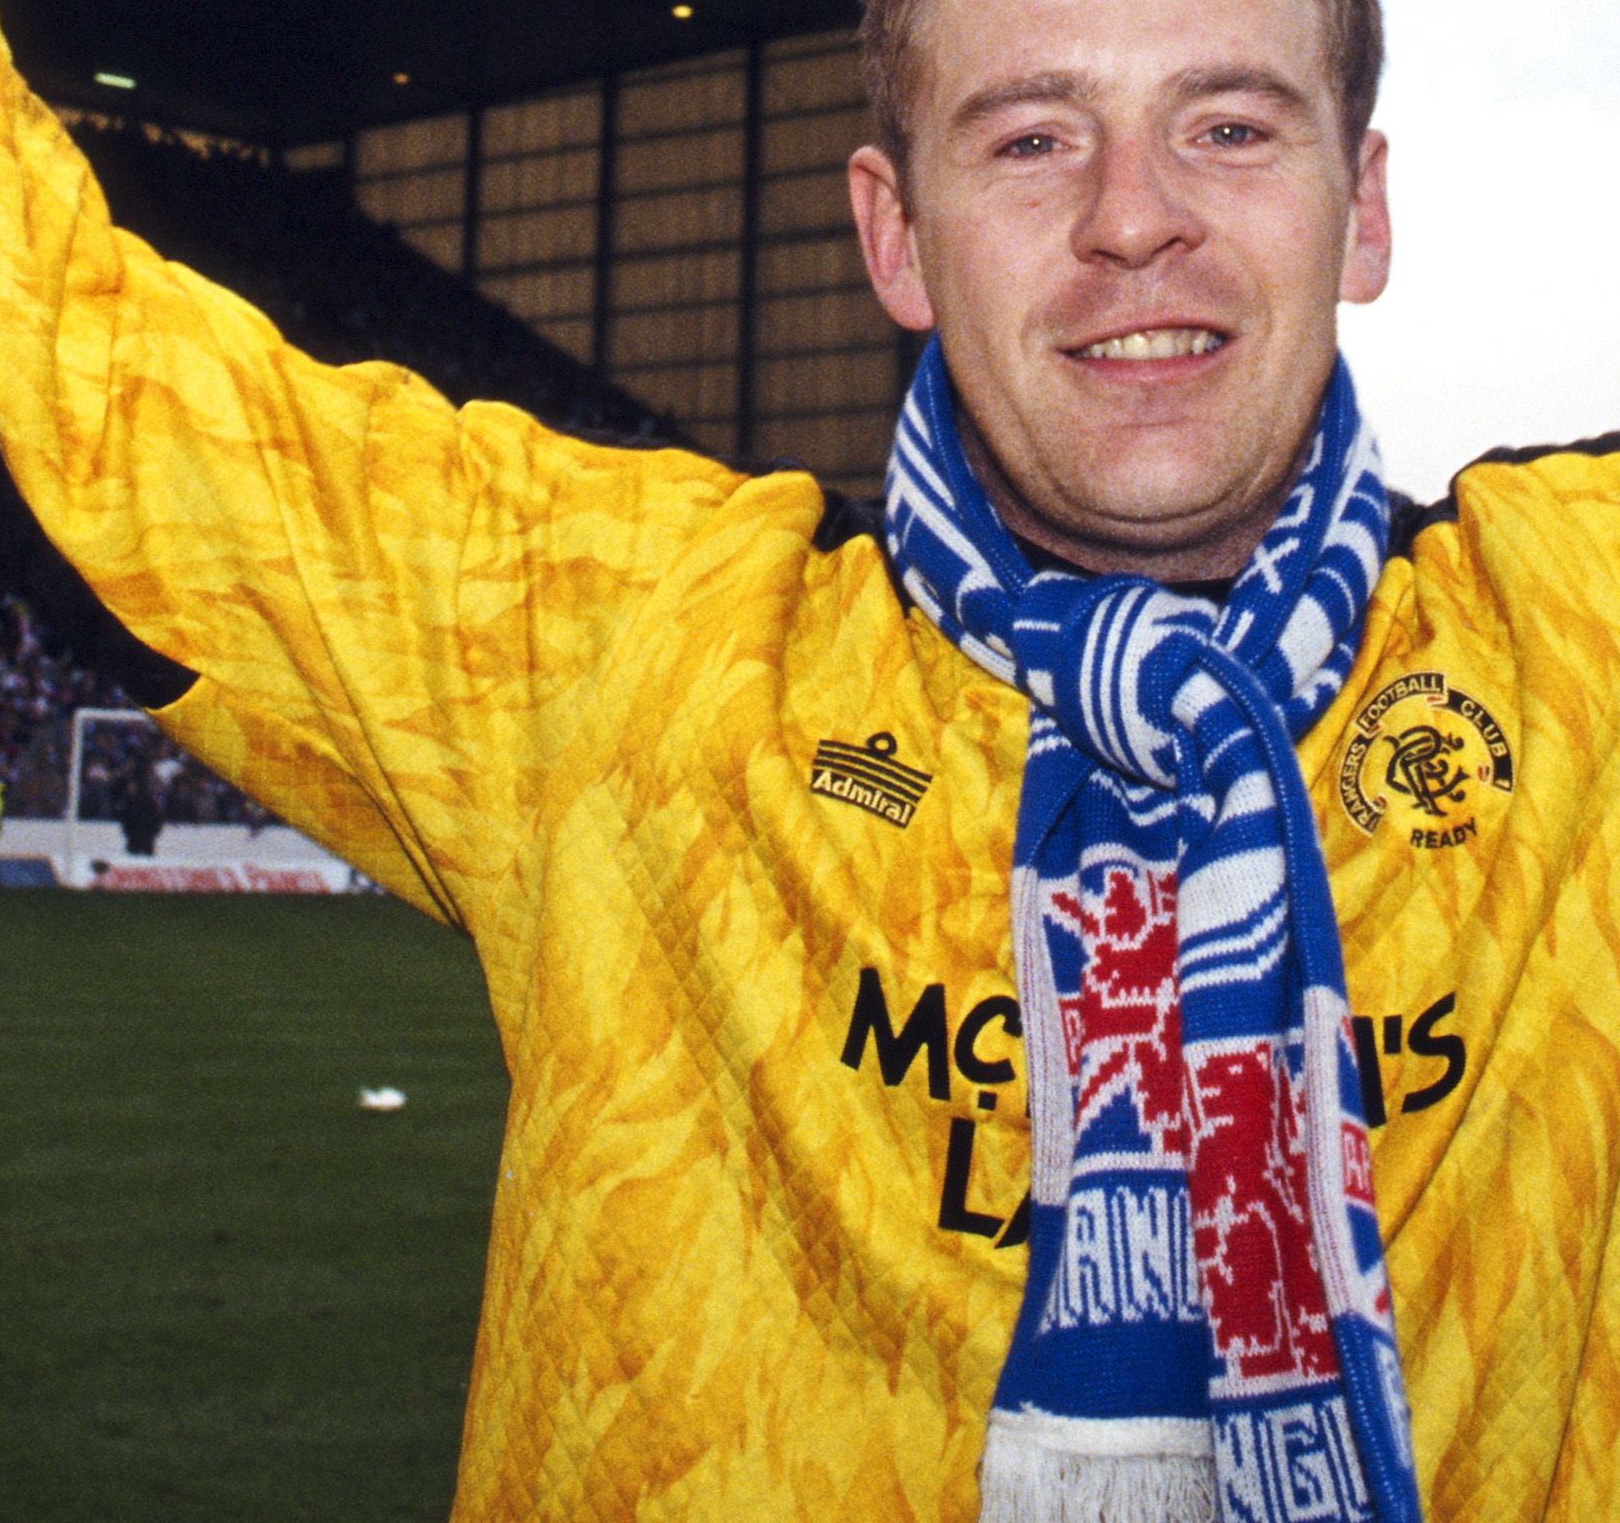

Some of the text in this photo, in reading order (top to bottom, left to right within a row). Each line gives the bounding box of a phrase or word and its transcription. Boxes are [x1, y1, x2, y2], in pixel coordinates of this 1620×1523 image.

[1358, 676, 1508, 757] FOOTBALL CLUB
[812, 769, 912, 825] Admiral
[1342, 742, 1377, 827] RANGERS
[1410, 816, 1479, 849] READY
